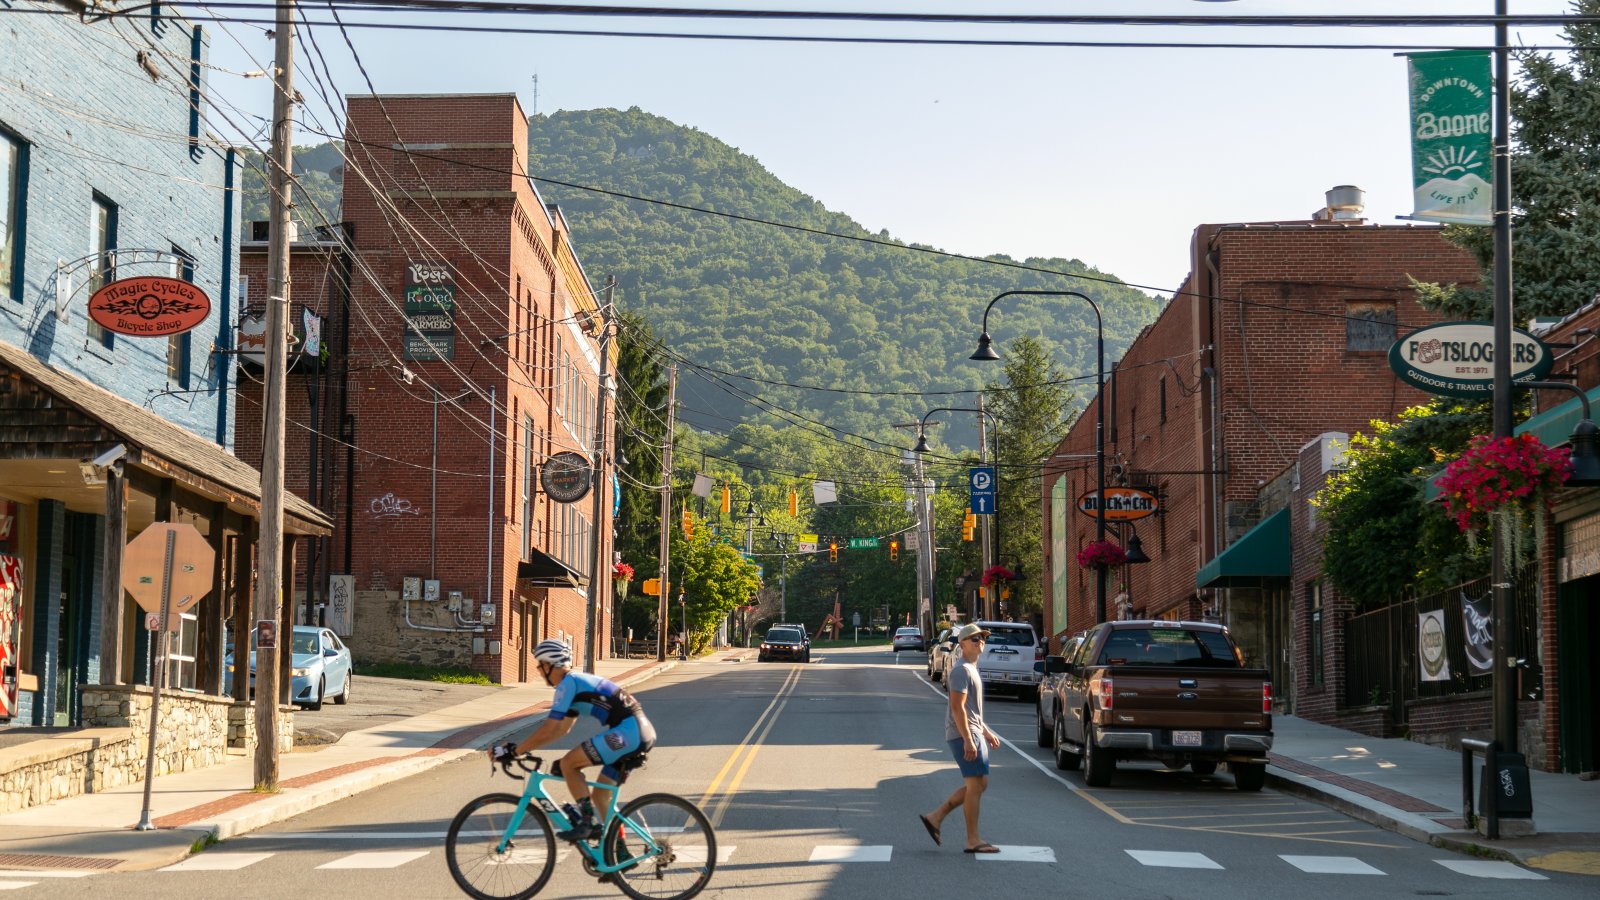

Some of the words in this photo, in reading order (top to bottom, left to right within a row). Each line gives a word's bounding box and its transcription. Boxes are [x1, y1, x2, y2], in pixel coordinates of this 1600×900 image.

[1421, 77, 1484, 102] DOWNTOWN
[1417, 112, 1489, 140] Boone
[1430, 190, 1453, 204] LIVE
[1457, 195, 1466, 205] IT
[1467, 187, 1479, 200] UP
[104, 282, 148, 302] Magic
[152, 281, 196, 300] Cycles
[116, 318, 154, 332] Bicycle
[156, 319, 182, 331] Shop
[1408, 370, 1446, 389] OUTDOOR
[1456, 383, 1486, 391] TRAVEL
[549, 482, 584, 498] PROVISIONS
[1084, 497, 1123, 509] BLCK
[1133, 497, 1153, 509] CAT
